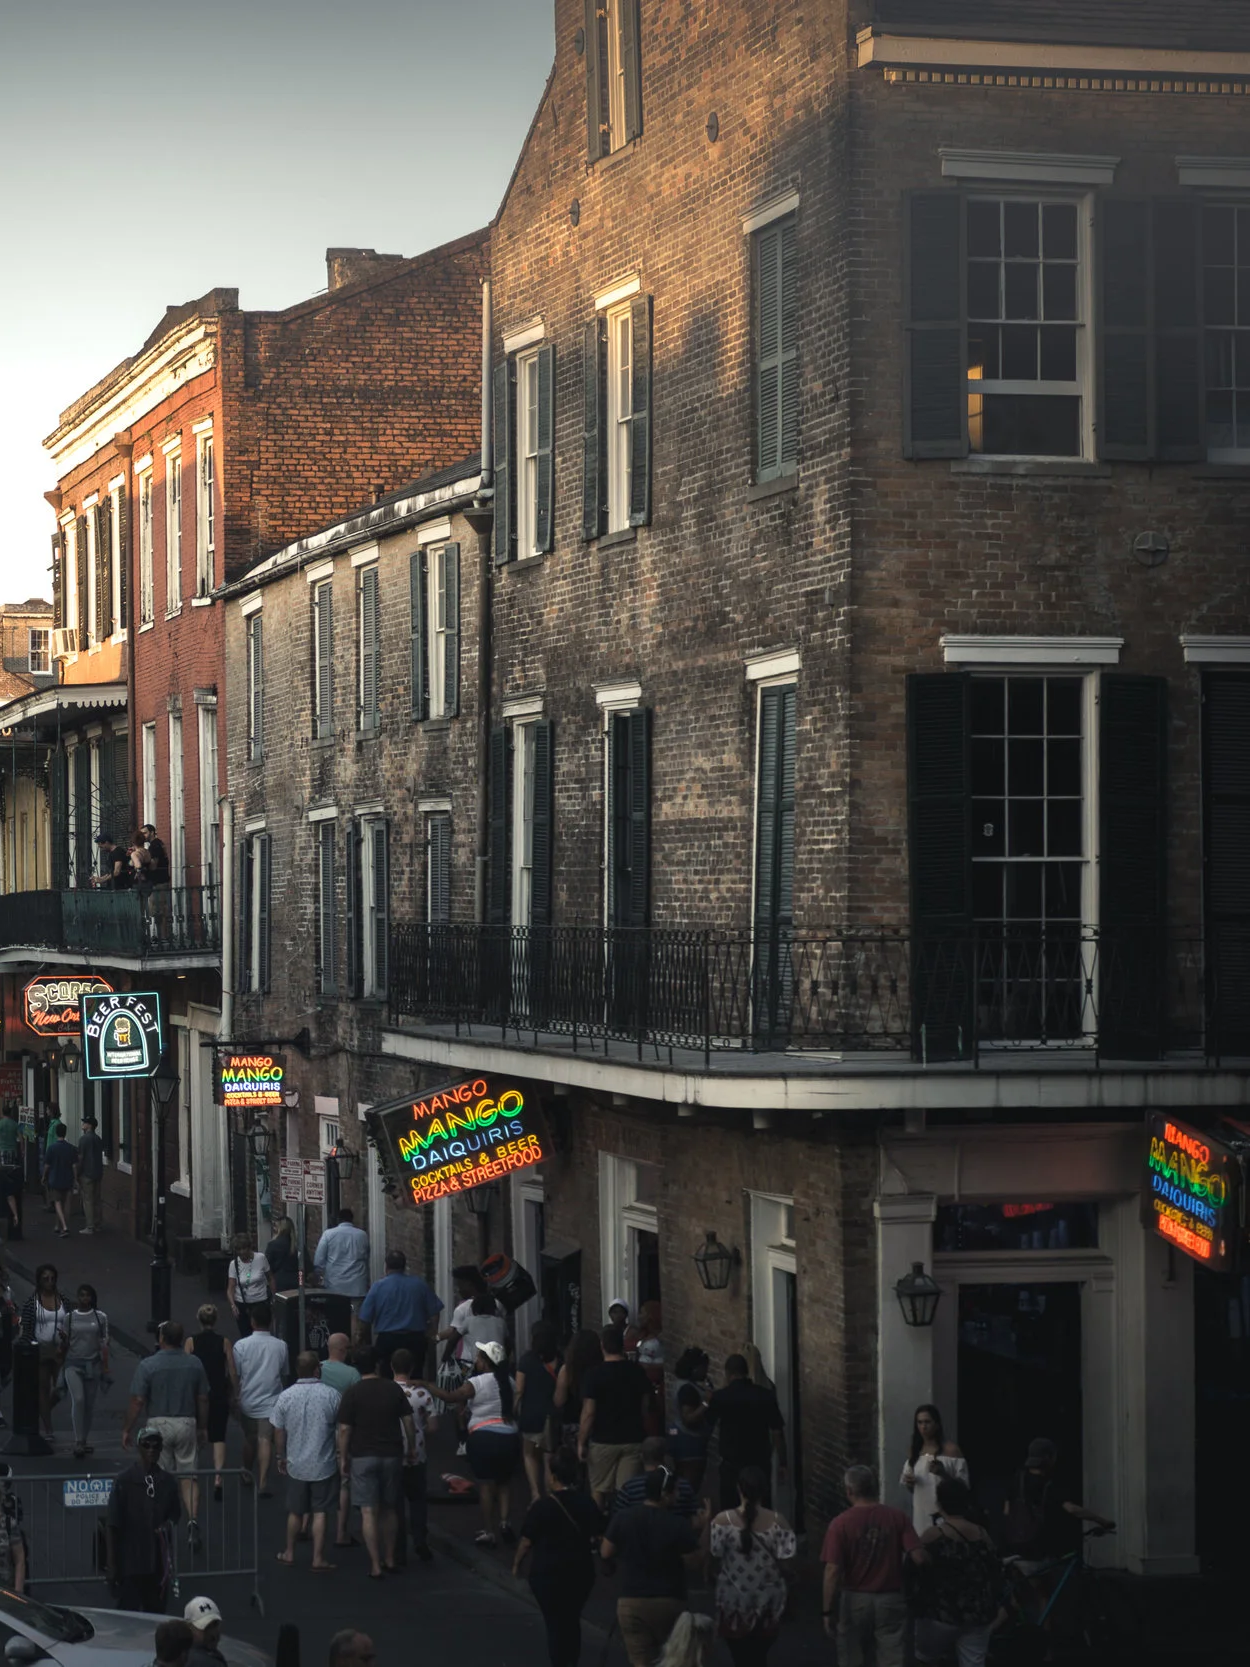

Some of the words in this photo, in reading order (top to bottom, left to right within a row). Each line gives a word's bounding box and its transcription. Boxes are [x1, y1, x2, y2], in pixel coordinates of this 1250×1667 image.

[31, 1010, 60, 1026] New
[87, 996, 121, 1038] BEER
[126, 996, 159, 1033] FEST
[222, 1066, 283, 1082] MANGO
[230, 1057, 273, 1067] MANGO
[224, 1082, 281, 1092] DAIQUIRIS
[412, 1079, 487, 1120] MANGO
[399, 1090, 524, 1162] MANGO
[411, 1120, 523, 1170] DAIQUIRIS
[1164, 1121, 1210, 1164] MANGO
[411, 1157, 473, 1190] COCKTAILS
[479, 1152, 490, 1165] &
[496, 1134, 539, 1158] BEER
[1148, 1136, 1227, 1208] MANGO
[413, 1181, 450, 1204] PIZZA
[450, 1176, 461, 1191] &
[1152, 1174, 1216, 1228] DAIQUIRIS
